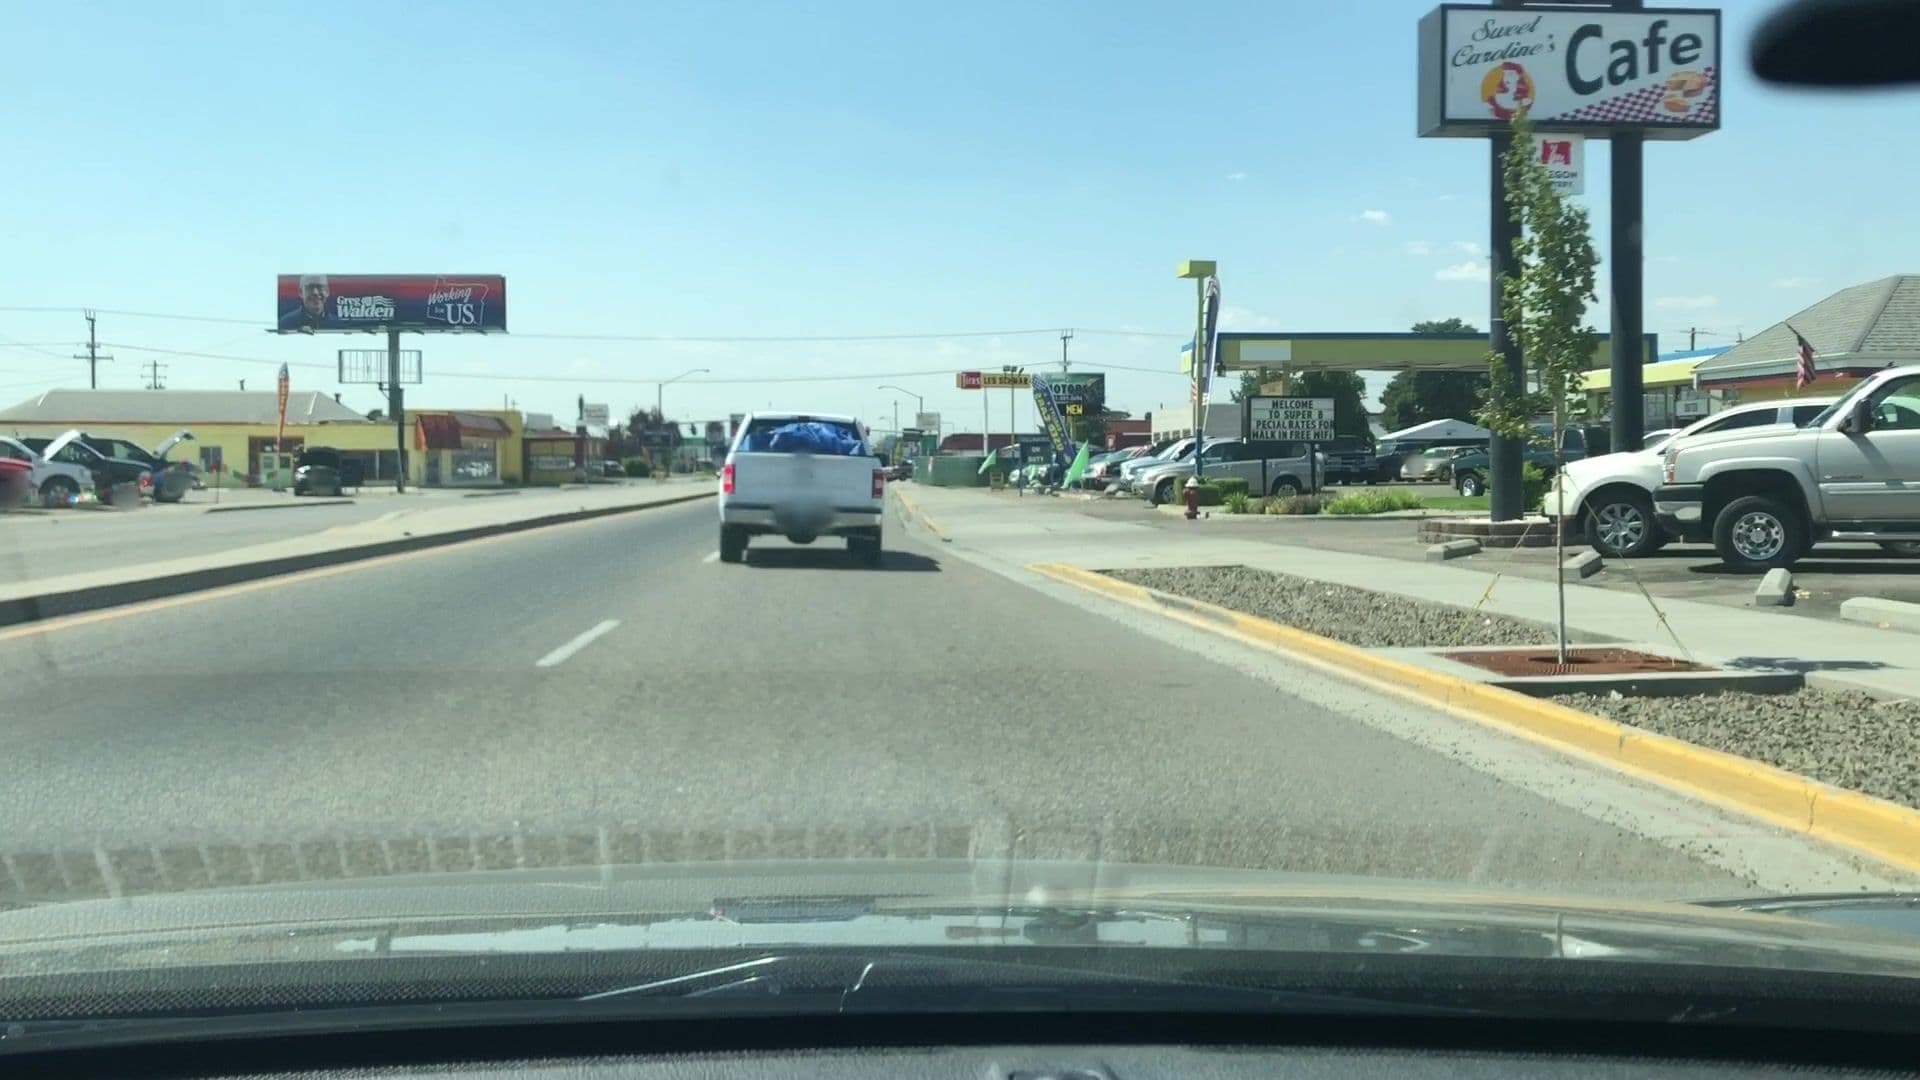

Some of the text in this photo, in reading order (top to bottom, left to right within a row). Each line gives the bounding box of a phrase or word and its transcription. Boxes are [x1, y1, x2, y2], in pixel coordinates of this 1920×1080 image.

[1472, 16, 1542, 42] Sweet
[1452, 34, 1555, 68] Caroline's
[1566, 20, 1703, 96] Cafe
[428, 287, 471, 305] Working
[337, 304, 394, 317] Walden
[445, 304, 475, 324] US
[1066, 404, 1083, 415] NEW
[1272, 400, 1313, 409] WELCOME
[1269, 410, 1280, 419] TO
[1284, 410, 1312, 419] SUPER
[1256, 420, 1286, 429] PECIAL
[1289, 420, 1316, 429] RATES
[1252, 430, 1333, 439] WALK IN FREE WIFI
